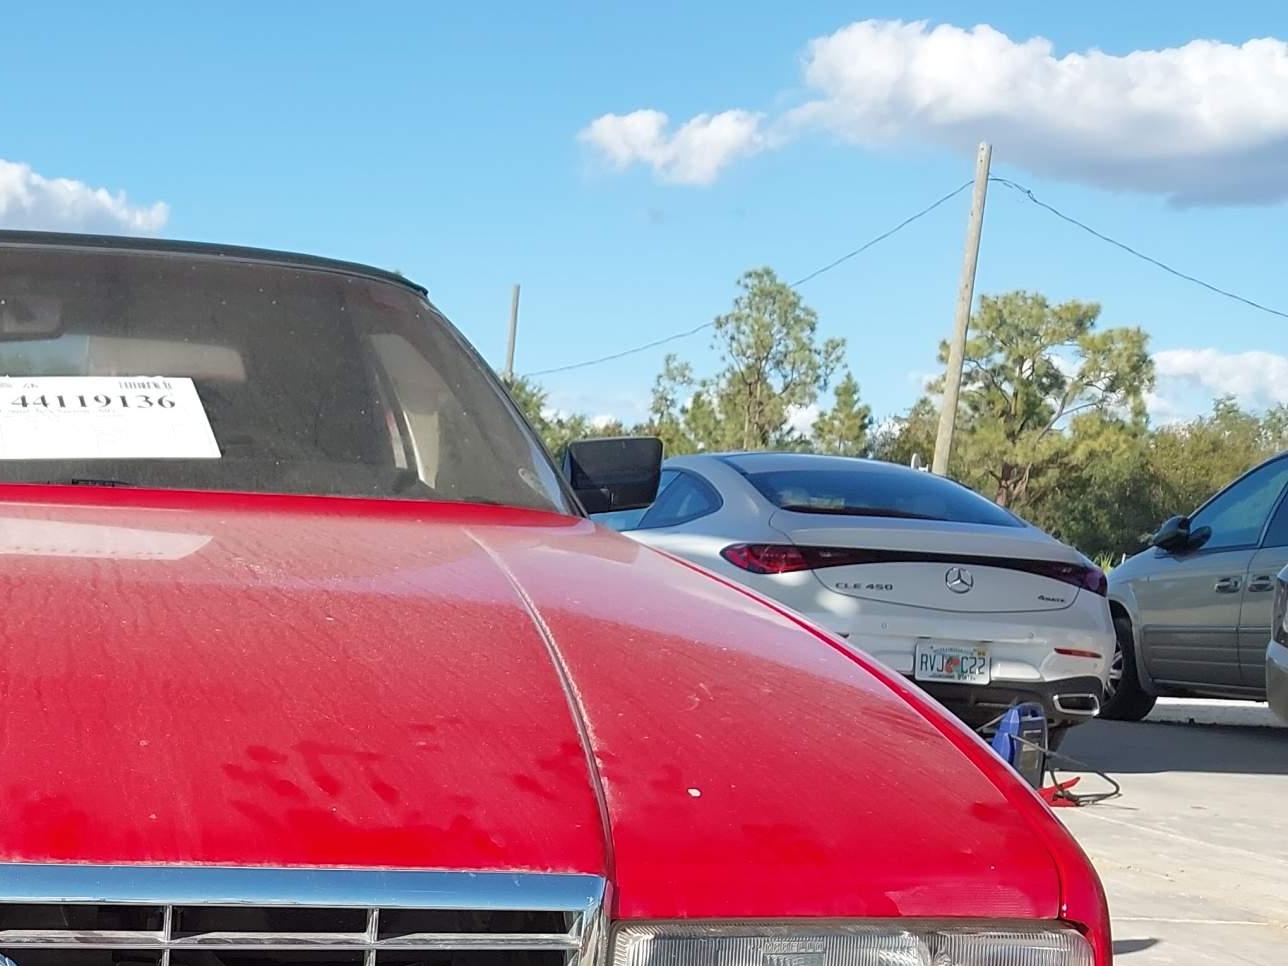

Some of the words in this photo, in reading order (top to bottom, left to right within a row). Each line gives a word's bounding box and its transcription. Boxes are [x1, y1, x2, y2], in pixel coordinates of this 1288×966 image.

[11, 394, 176, 408] 44119136
[835, 582, 861, 590] CLE
[865, 583, 894, 591] 450
[920, 653, 945, 672] RVJ
[960, 656, 986, 675] C22
